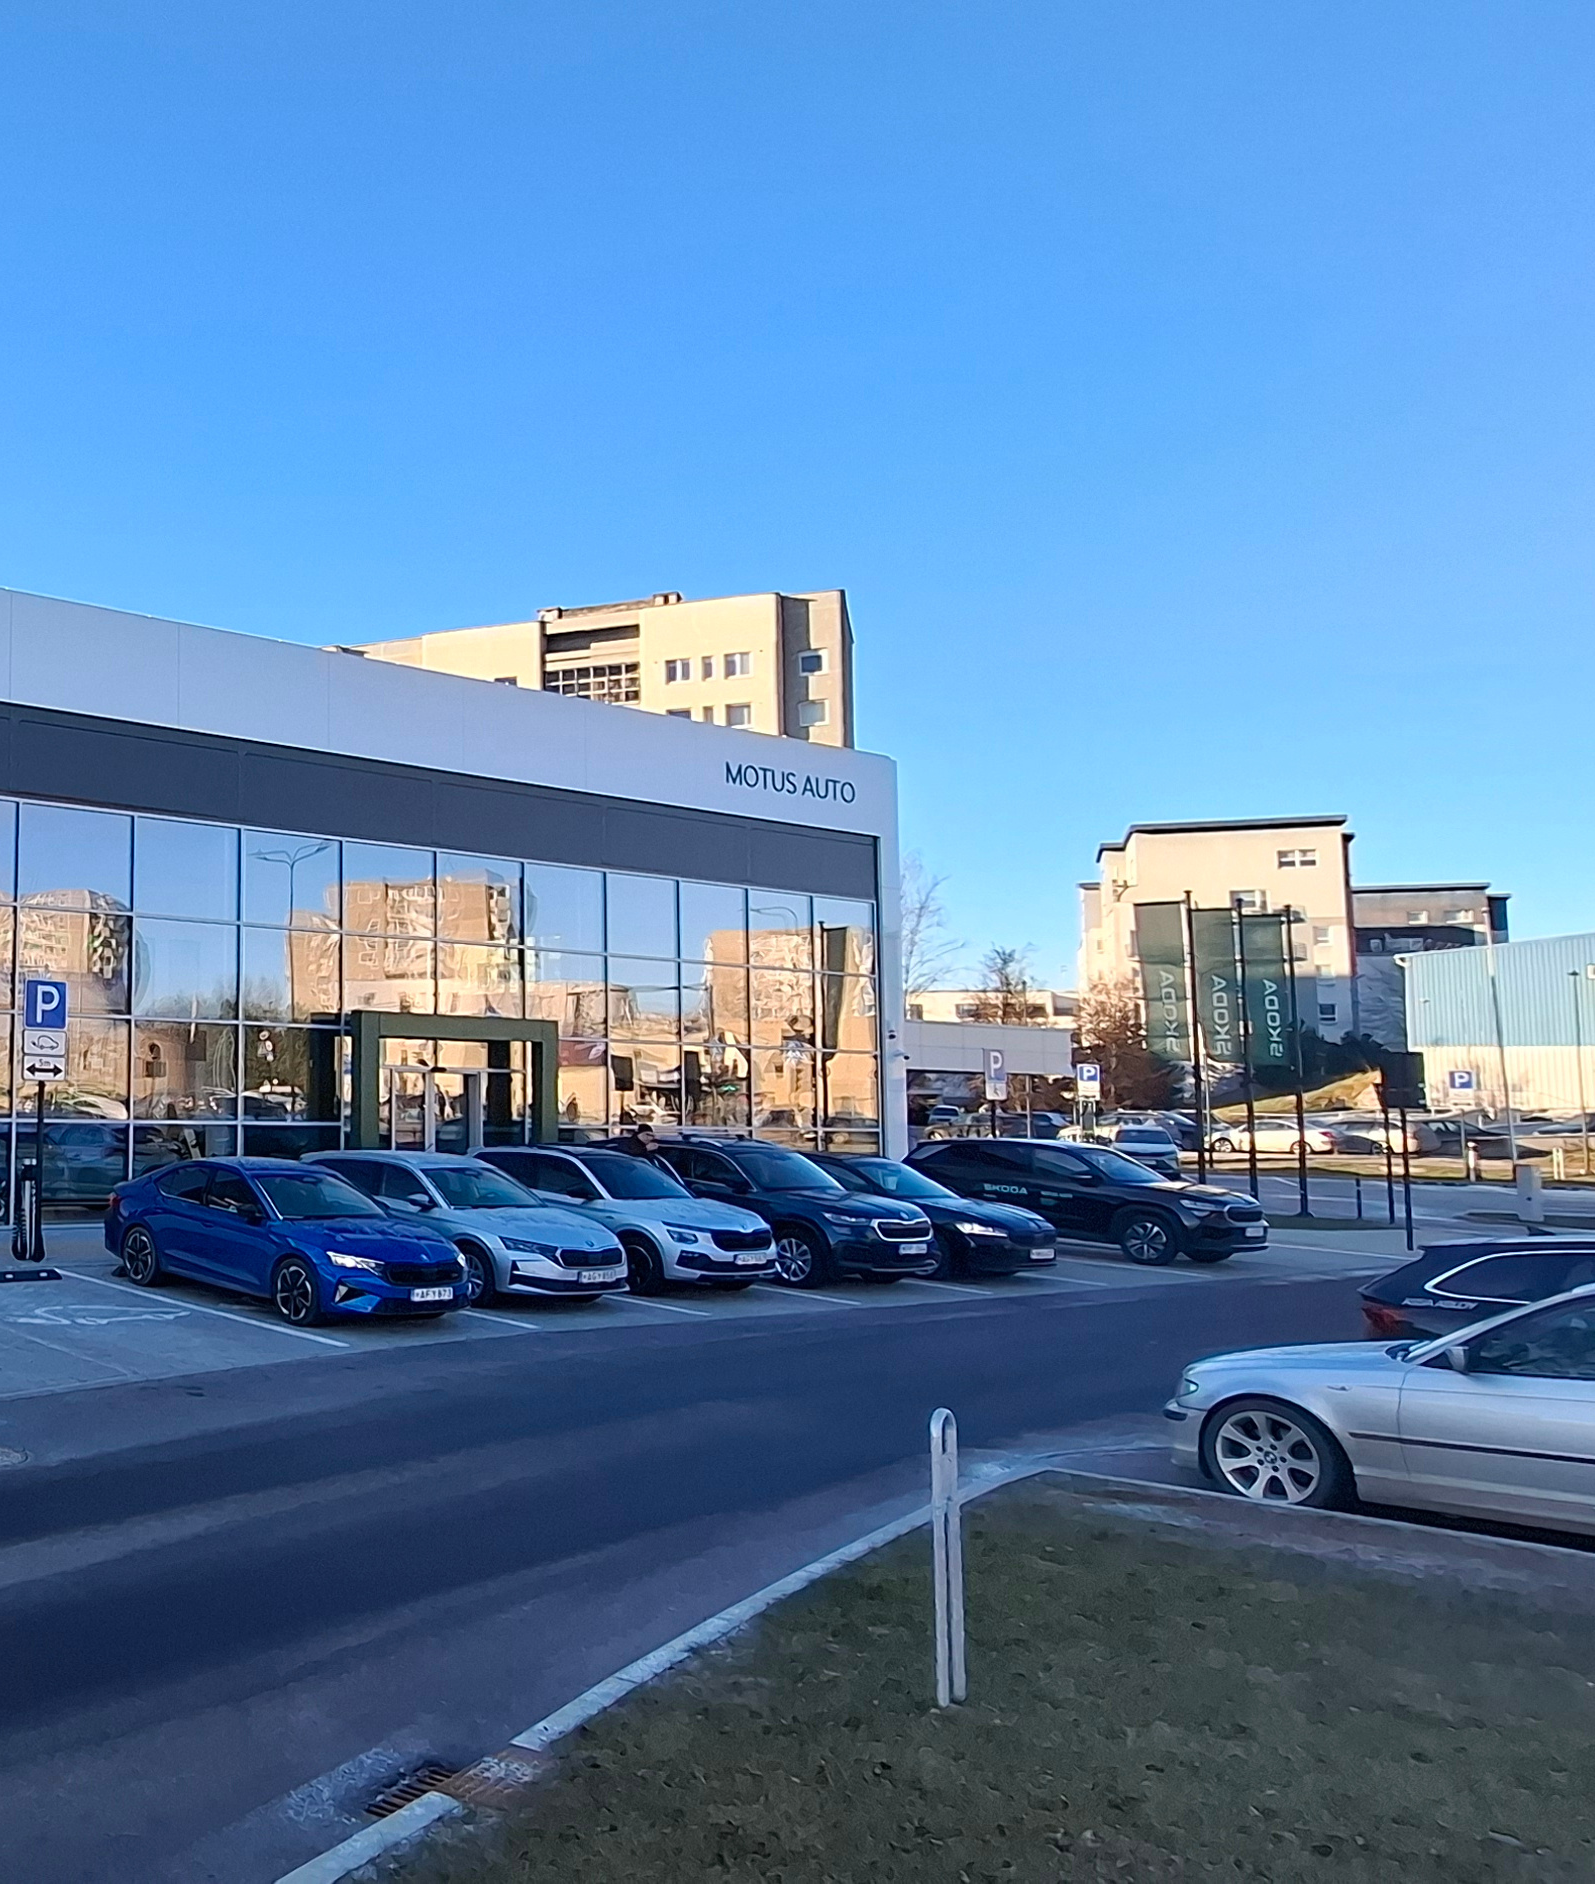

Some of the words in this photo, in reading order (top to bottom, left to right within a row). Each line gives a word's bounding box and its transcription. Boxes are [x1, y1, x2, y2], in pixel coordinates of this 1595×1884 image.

[725, 760, 798, 795] MOTUS
[801, 774, 856, 804] AUTO
[36, 984, 60, 1024] P
[989, 1051, 1003, 1078] P
[1083, 1066, 1096, 1081] P
[1454, 1072, 1469, 1088] P
